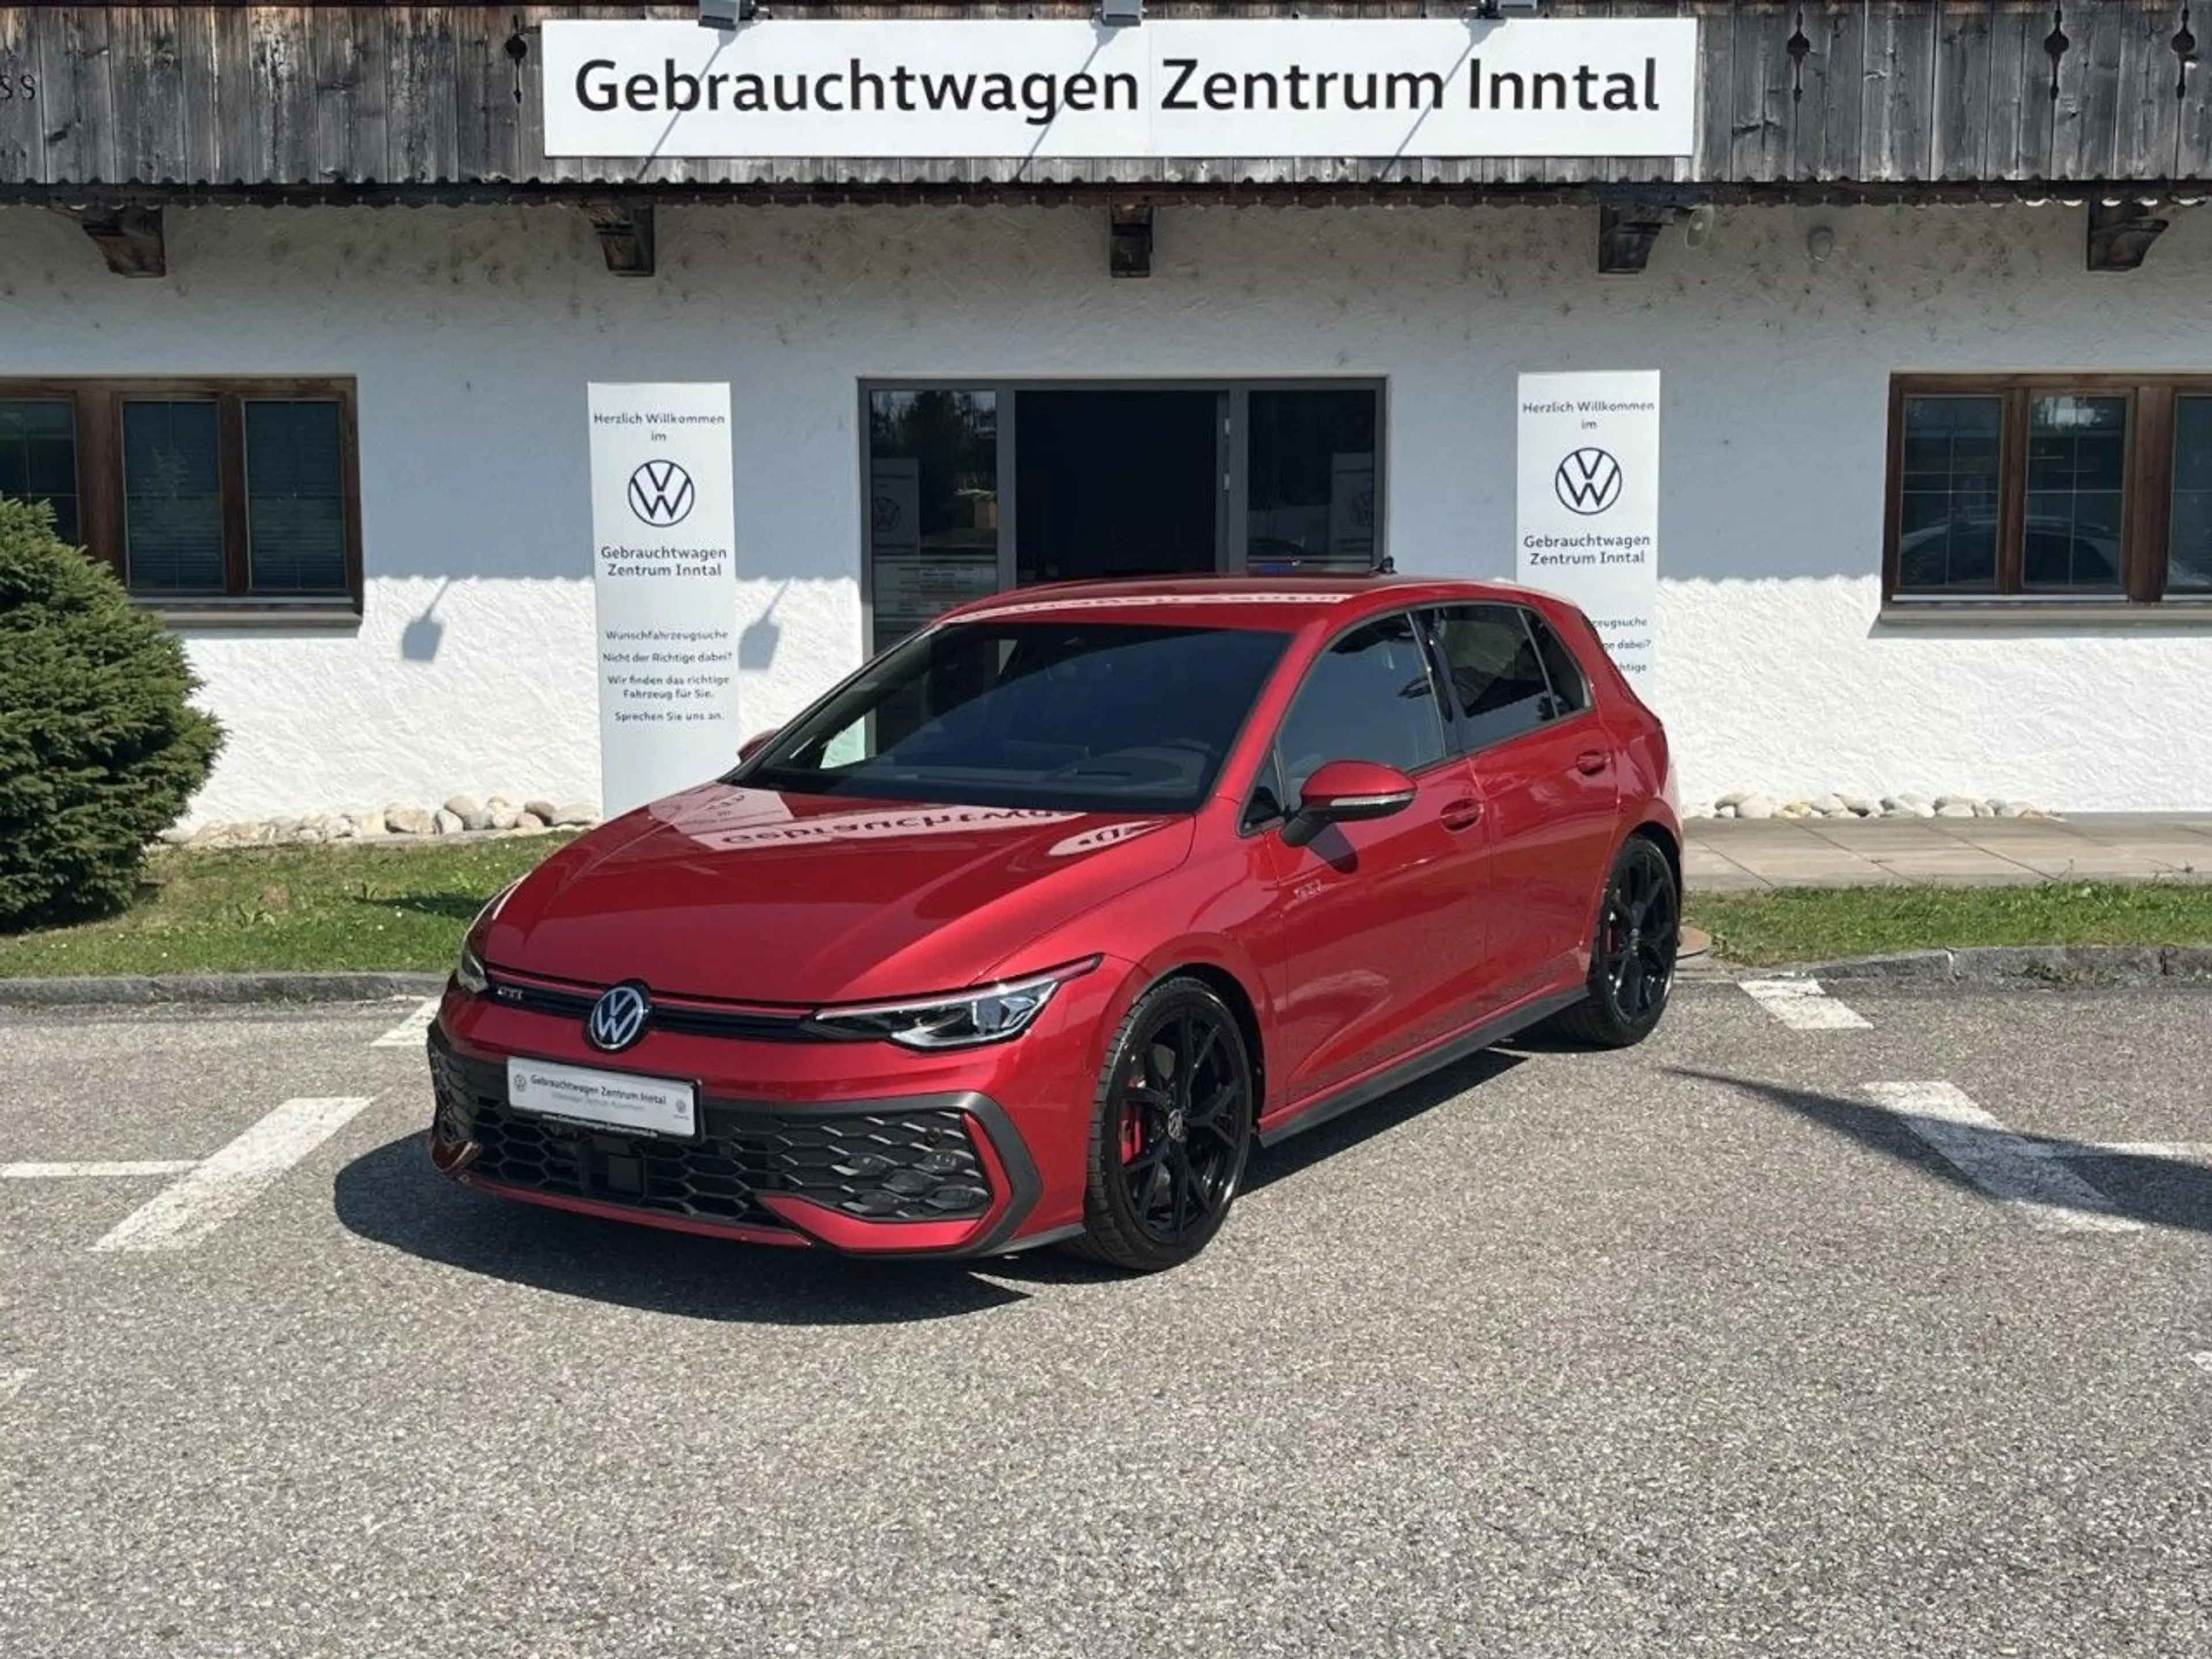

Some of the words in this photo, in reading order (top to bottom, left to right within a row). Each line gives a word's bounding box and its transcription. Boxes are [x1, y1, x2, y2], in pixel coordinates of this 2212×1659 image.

[576, 58, 1138, 125] Gebrauchtwagen
[1161, 59, 1445, 111] Zentrum
[1469, 58, 1660, 111] Inntal
[1522, 401, 1574, 413] Herzlich
[1578, 401, 1655, 412] Willkommen
[594, 413, 642, 425] Herzlich
[646, 412, 725, 425] Willkommen
[1582, 420, 1597, 430] im
[652, 432, 667, 442] im
[1524, 534, 1650, 549] Gebrauchtwagen
[601, 547, 728, 560] Gebrauchtwagen
[1530, 552, 1596, 565] Zentrum
[1600, 551, 1645, 565] Inntal
[607, 565, 672, 576] Zentrum
[676, 563, 722, 576] Inntal
[605, 630, 729, 642] Wunschfahrzeugsuche
[603, 653, 630, 662] Nicht
[652, 653, 695, 664] Richtige
[698, 652, 733, 662] dabei?
[607, 675, 628, 684] Wir
[629, 675, 662, 684] finden
[665, 675, 684, 685] das
[687, 675, 730, 686] richtige
[623, 689, 673, 700] Fahrzeug
[615, 711, 664, 723] Sprechen
[666, 711, 682, 721] Sie
[685, 713, 705, 721] uns
[531, 1074, 598, 1096] Gebrauchtwagen
[601, 1086, 639, 1101] Zentrum
